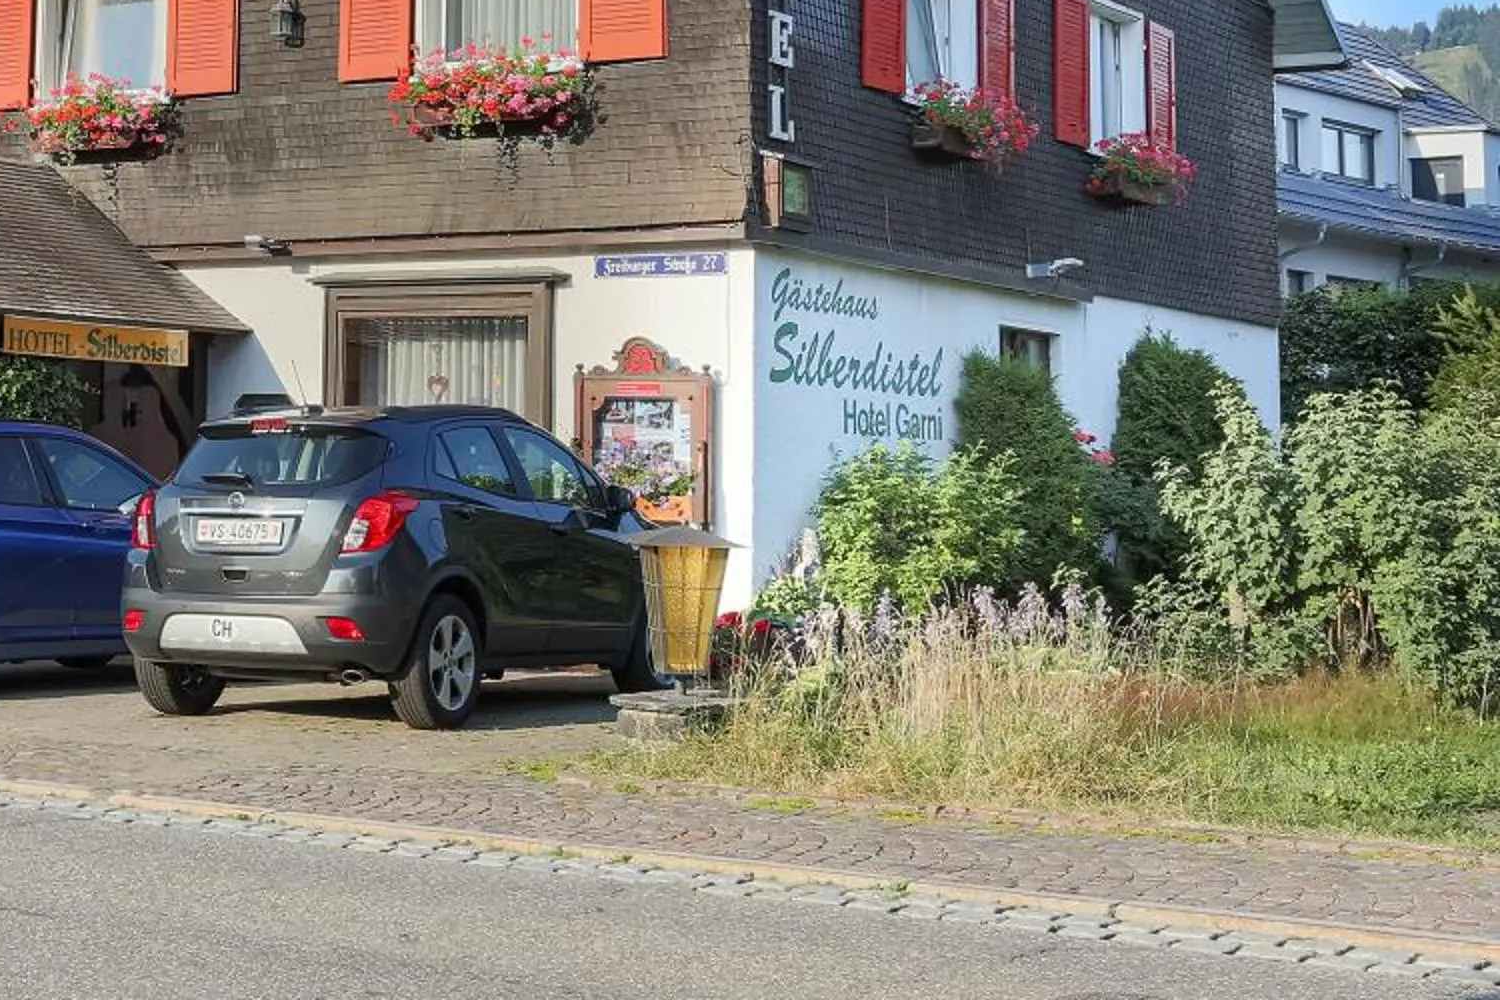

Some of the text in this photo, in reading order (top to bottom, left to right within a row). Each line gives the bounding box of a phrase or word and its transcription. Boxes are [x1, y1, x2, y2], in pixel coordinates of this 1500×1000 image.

[771, 267, 879, 321] Gästehaus
[9, 328, 77, 356] HOTEL
[87, 328, 185, 364] Silberdistel
[769, 321, 943, 397] Silberdistel
[843, 398, 943, 440] Hotel Garni
[211, 618, 233, 638] CH
